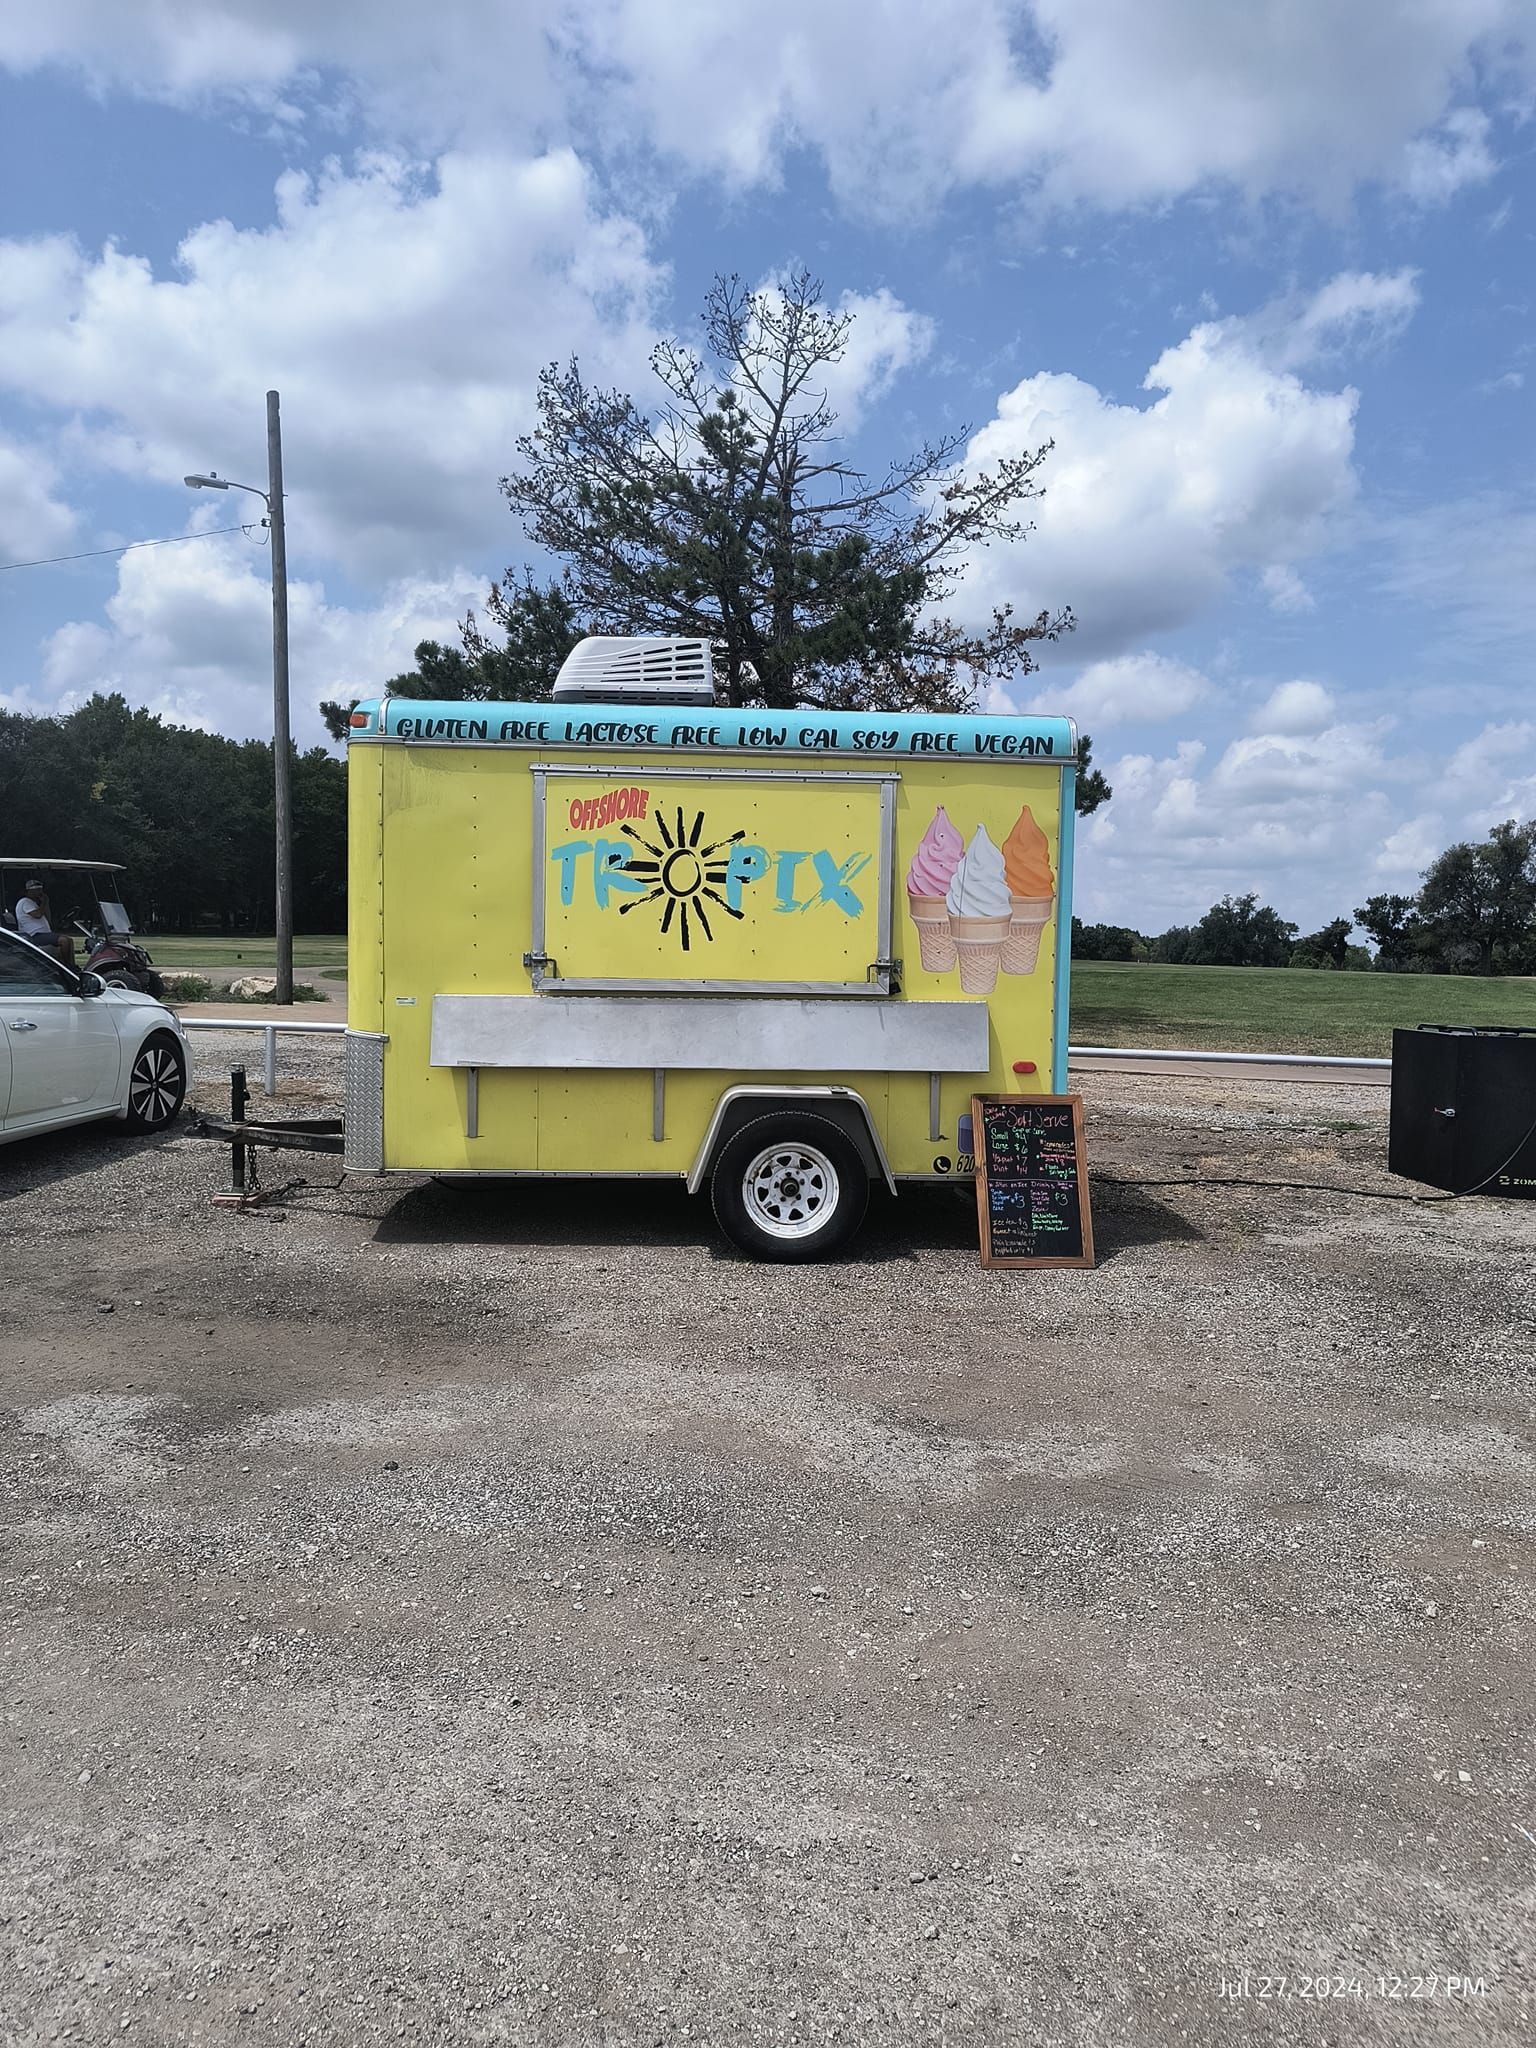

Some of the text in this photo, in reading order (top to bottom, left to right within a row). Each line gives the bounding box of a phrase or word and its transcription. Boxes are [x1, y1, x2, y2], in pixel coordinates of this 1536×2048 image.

[396, 718, 1054, 755] GLUTEN FREE LACTOSE FREE LOW CAL SOY FREE VEGAN
[569, 787, 650, 831] OFFSHORE
[551, 838, 872, 919] TROPIX
[1006, 1106, 1069, 1128] Soft Serve
[990, 1128, 1009, 1140] Small
[991, 1140, 1009, 1153] Large
[1013, 1143, 1029, 1155] $6
[956, 1155, 976, 1172] 620
